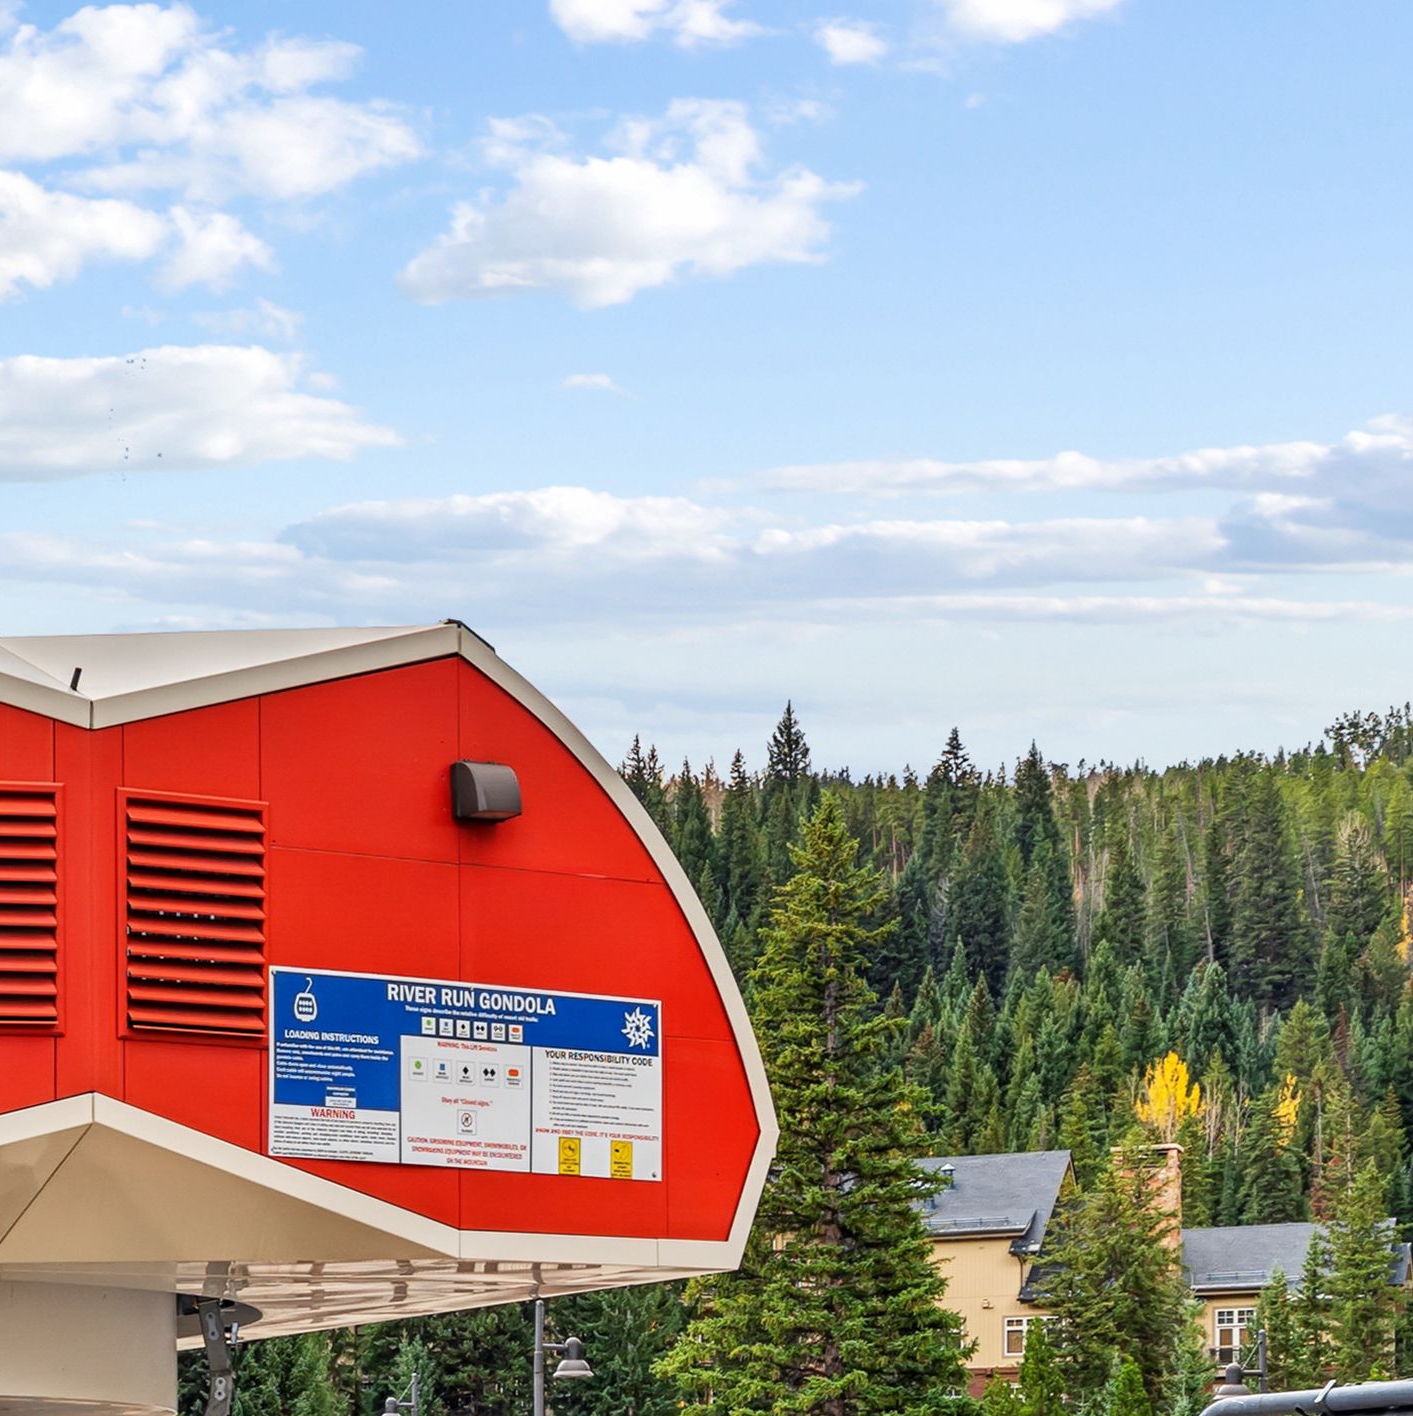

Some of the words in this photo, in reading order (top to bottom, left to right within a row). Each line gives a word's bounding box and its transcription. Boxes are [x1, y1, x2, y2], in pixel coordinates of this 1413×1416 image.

[387, 984, 436, 1005] RIVER
[442, 989, 474, 1008] RUN
[480, 993, 556, 1015] GONDOLA
[284, 1029, 319, 1040] LOADING
[321, 1032, 379, 1044] INSTRUCTIONS
[545, 1050, 566, 1060] YOUR
[568, 1051, 630, 1064] RESPONSIBILITY
[631, 1057, 653, 1067] CODE
[310, 1108, 356, 1119] WARNING
